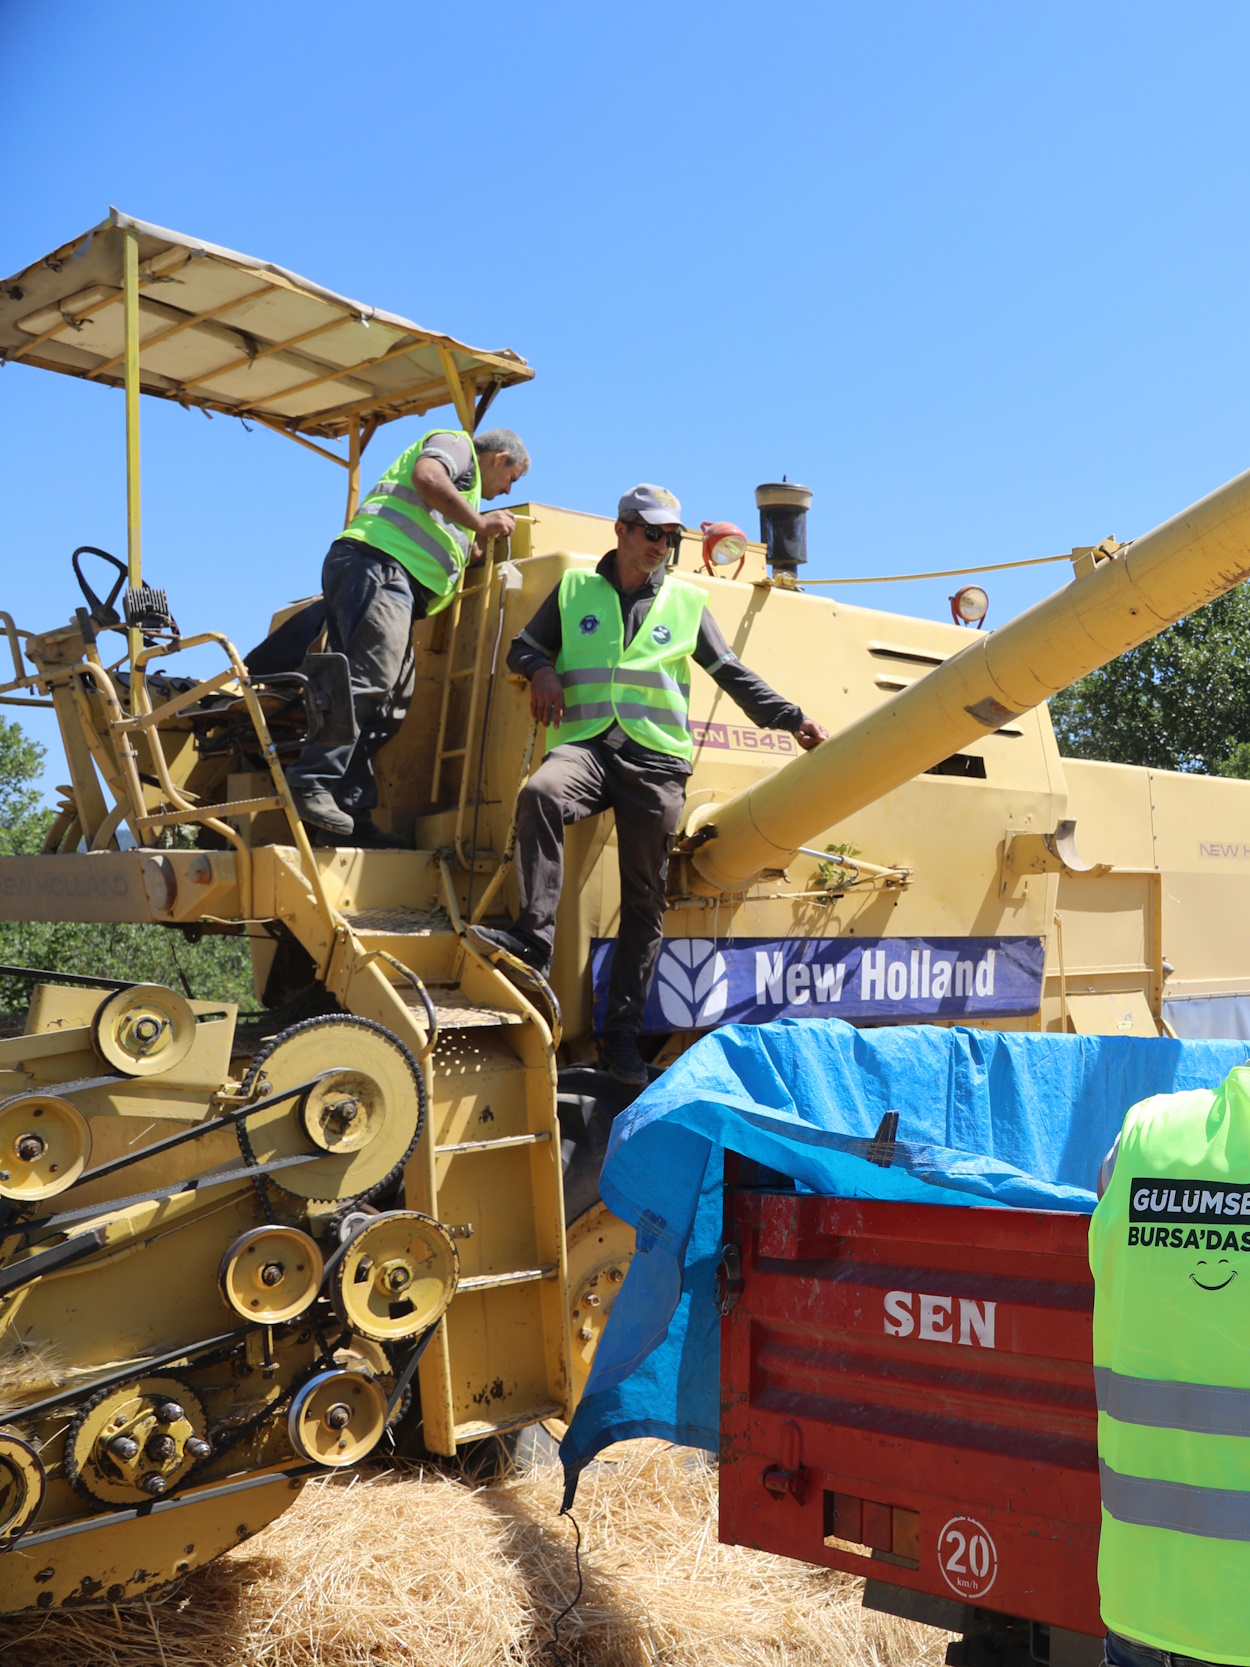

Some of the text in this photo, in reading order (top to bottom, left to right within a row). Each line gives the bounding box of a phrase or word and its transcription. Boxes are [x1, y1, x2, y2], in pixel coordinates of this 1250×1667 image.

[693, 728, 792, 752] ON 1545
[1200, 844, 1238, 857] NEW
[0, 876, 129, 897] EW HOLLAND
[755, 948, 996, 1005] New Holland
[883, 1290, 998, 1348] SEN
[946, 1530, 989, 1577] 20
[957, 1577, 979, 1590] km/h
